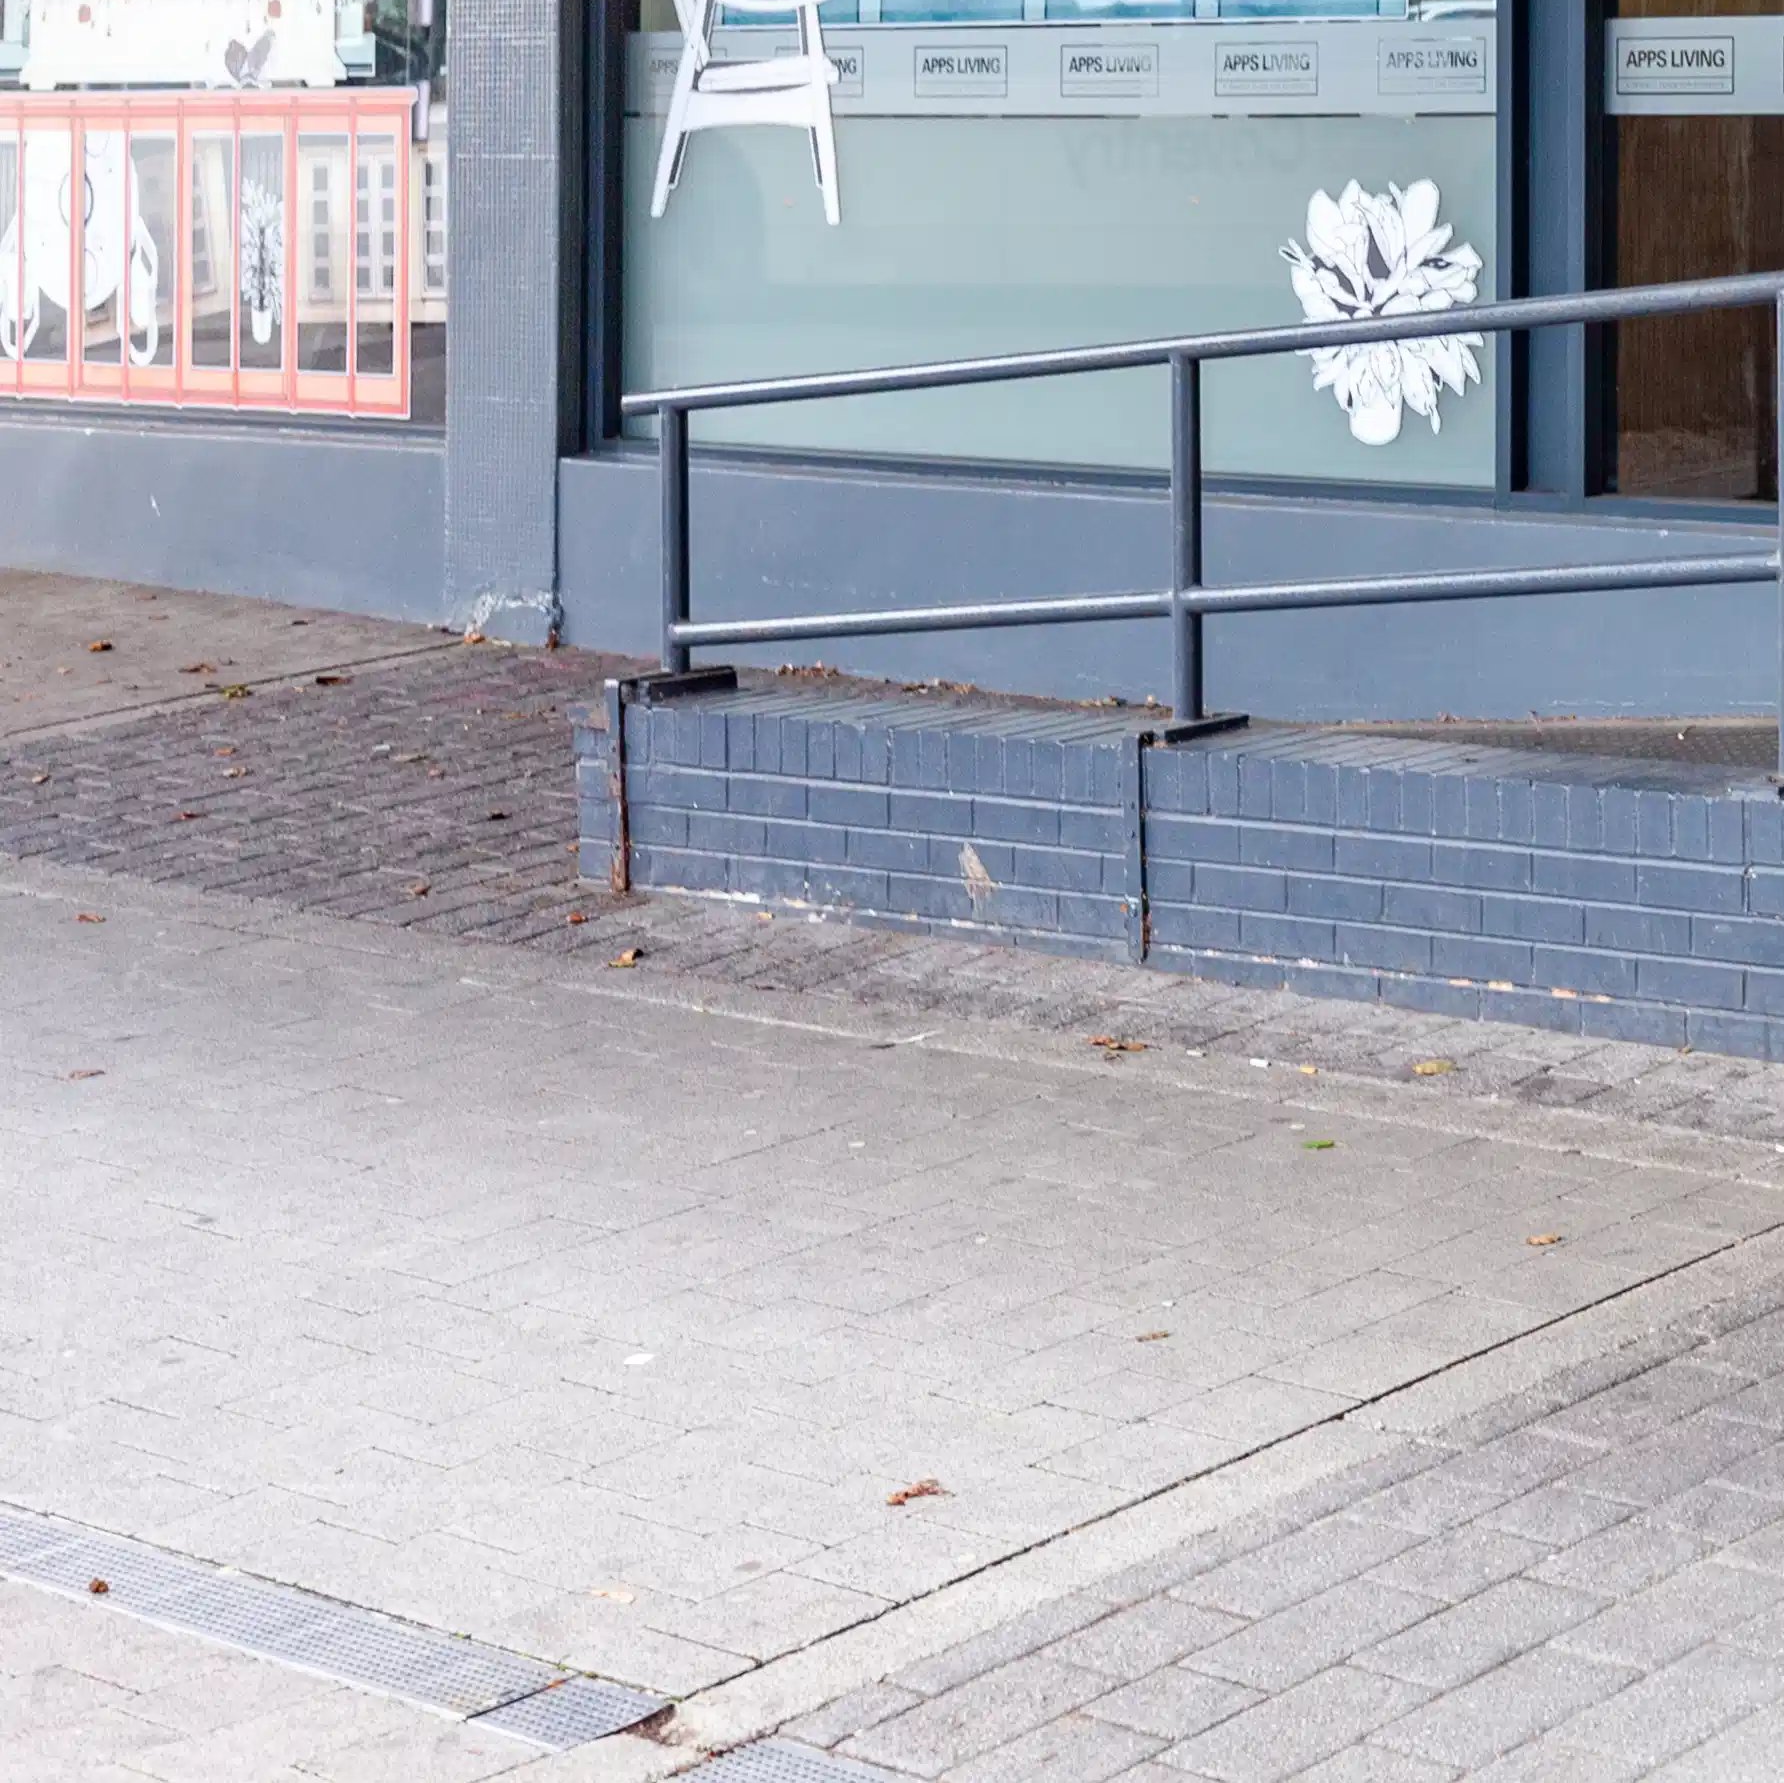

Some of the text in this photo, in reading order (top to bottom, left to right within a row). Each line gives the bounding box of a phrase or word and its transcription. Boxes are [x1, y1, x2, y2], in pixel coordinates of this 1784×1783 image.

[922, 58, 1000, 74] APPS LIVING
[1069, 56, 1102, 73] APPS
[1223, 52, 1310, 72] APPS LIVING
[1386, 51, 1423, 70] APPS
[1626, 49, 1725, 68] APPS LIVING
